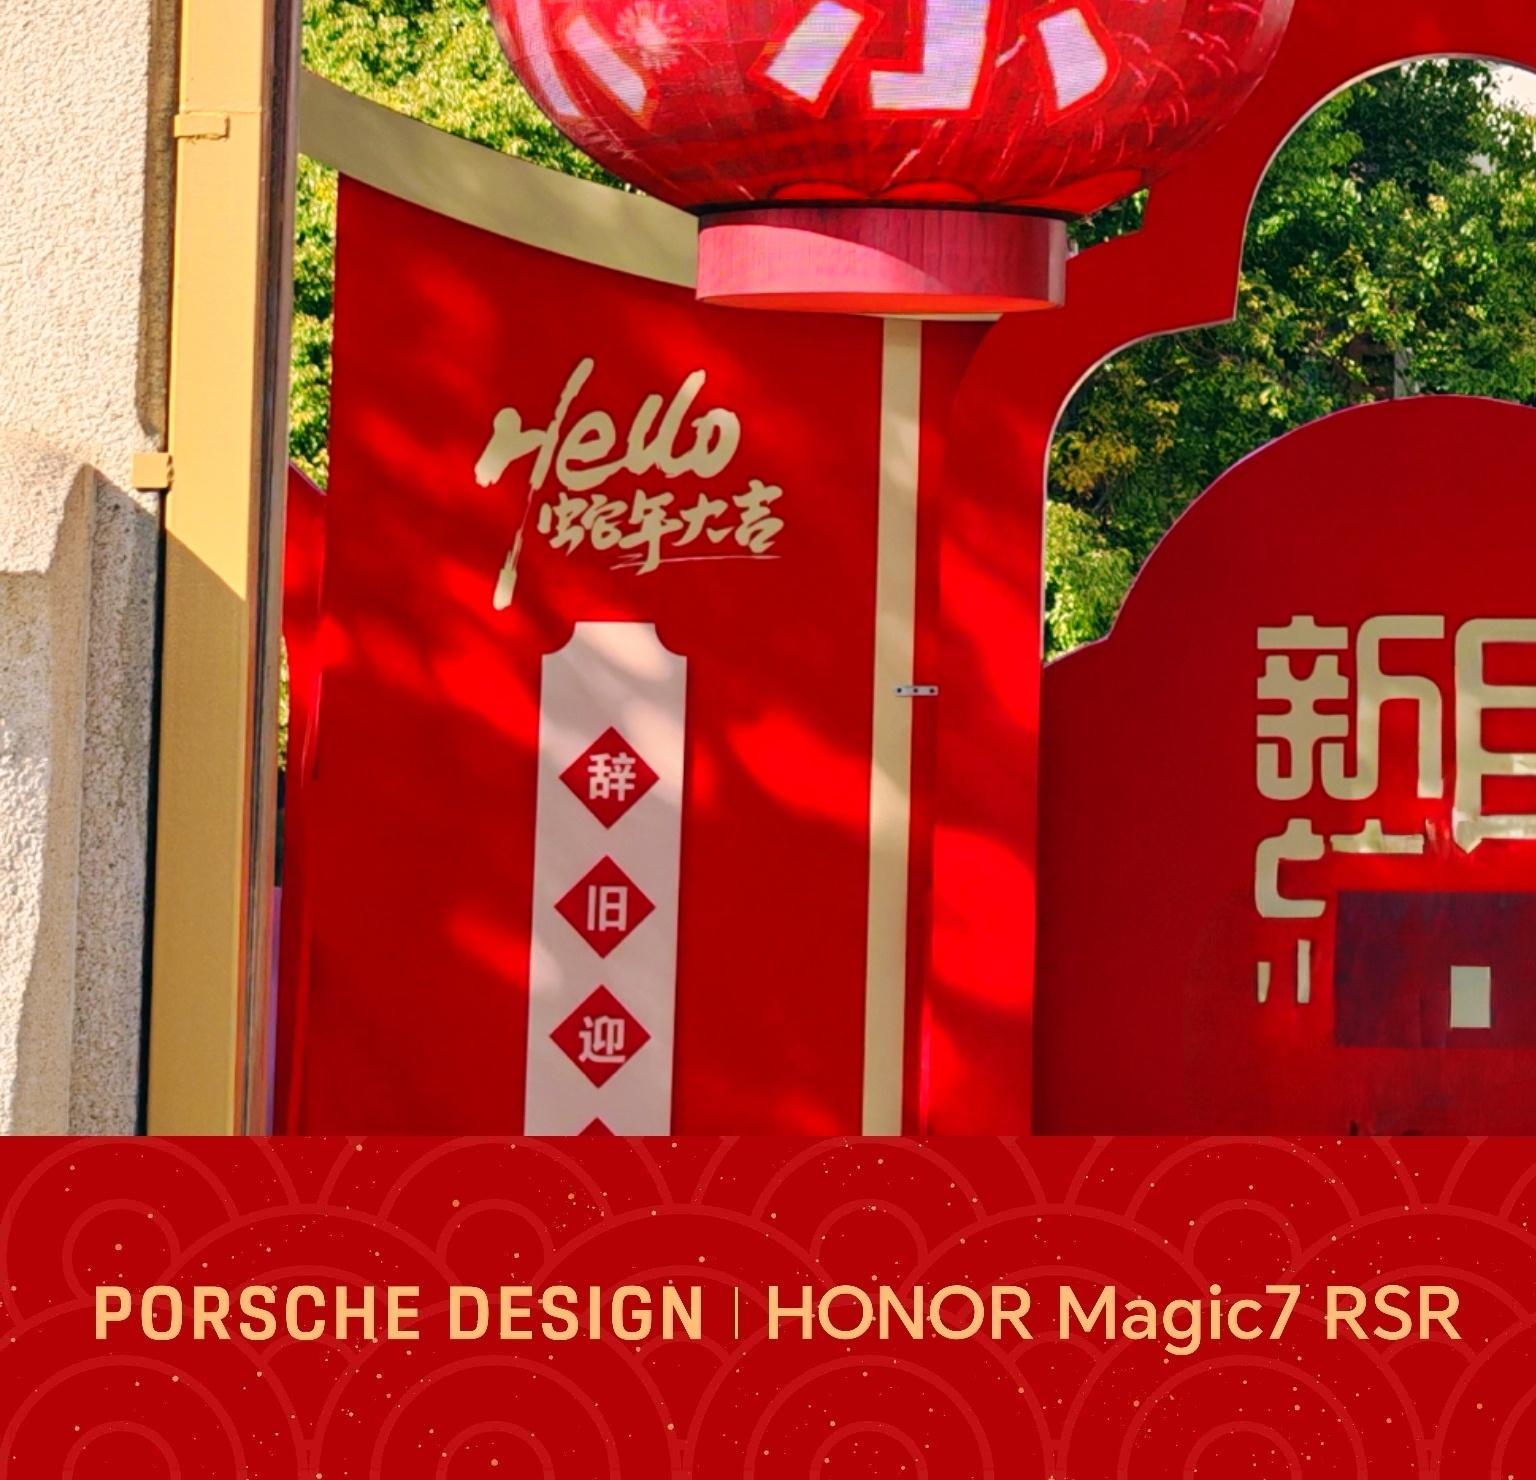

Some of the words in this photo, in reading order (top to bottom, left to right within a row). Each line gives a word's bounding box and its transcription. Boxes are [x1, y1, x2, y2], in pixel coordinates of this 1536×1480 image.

[474, 357, 741, 611] Hello
[536, 479, 785, 576] 蛇年大吉
